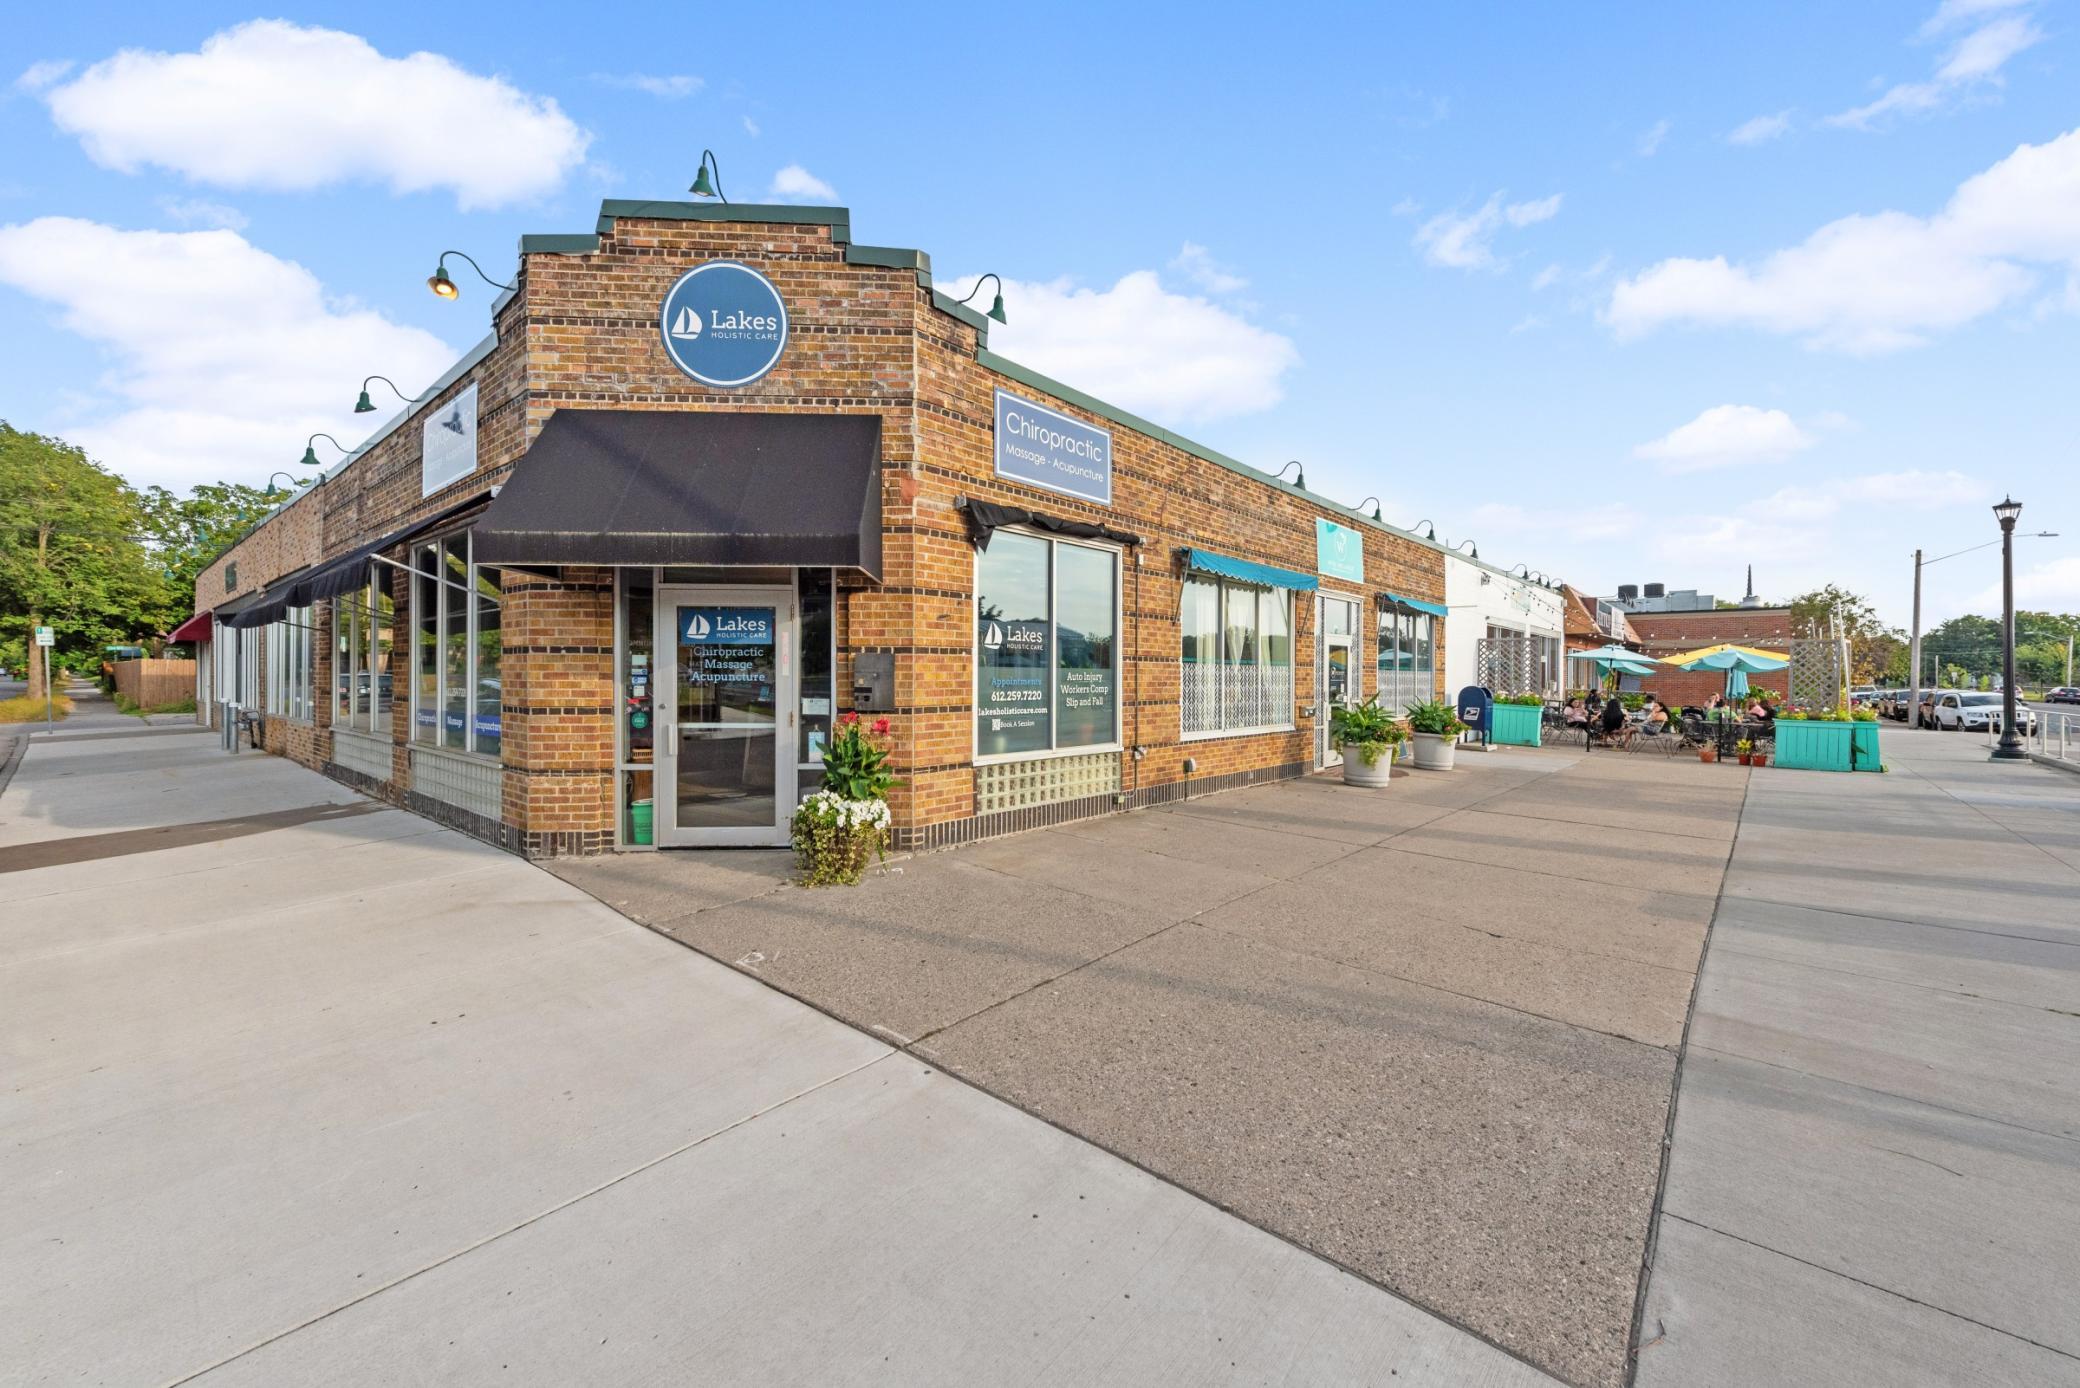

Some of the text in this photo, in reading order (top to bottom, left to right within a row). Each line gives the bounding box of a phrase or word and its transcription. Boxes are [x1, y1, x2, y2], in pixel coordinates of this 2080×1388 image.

[711, 309, 777, 331] Lakes
[711, 331, 779, 341] HOLISTIC CARE
[1006, 411, 1103, 462] Chiropractic
[1005, 442, 1046, 466] Massage
[1052, 458, 1104, 482] Acupuncture
[716, 616, 767, 631] Lakes
[1007, 625, 1043, 643] Lakes
[693, 646, 764, 659] Chiropractic
[1030, 643, 1044, 651] CARE
[704, 658, 753, 671] Massage
[691, 671, 766, 683] Acupuncture
[992, 677, 1042, 688] Appointments
[1066, 671, 1103, 683] Auto Injury
[1060, 684, 1109, 695] Workers Comp
[991, 690, 1042, 702] 612.259.7220
[1066, 696, 1104, 709] Slip and Fall
[978, 707, 1049, 717] lakesholisticcare.com
